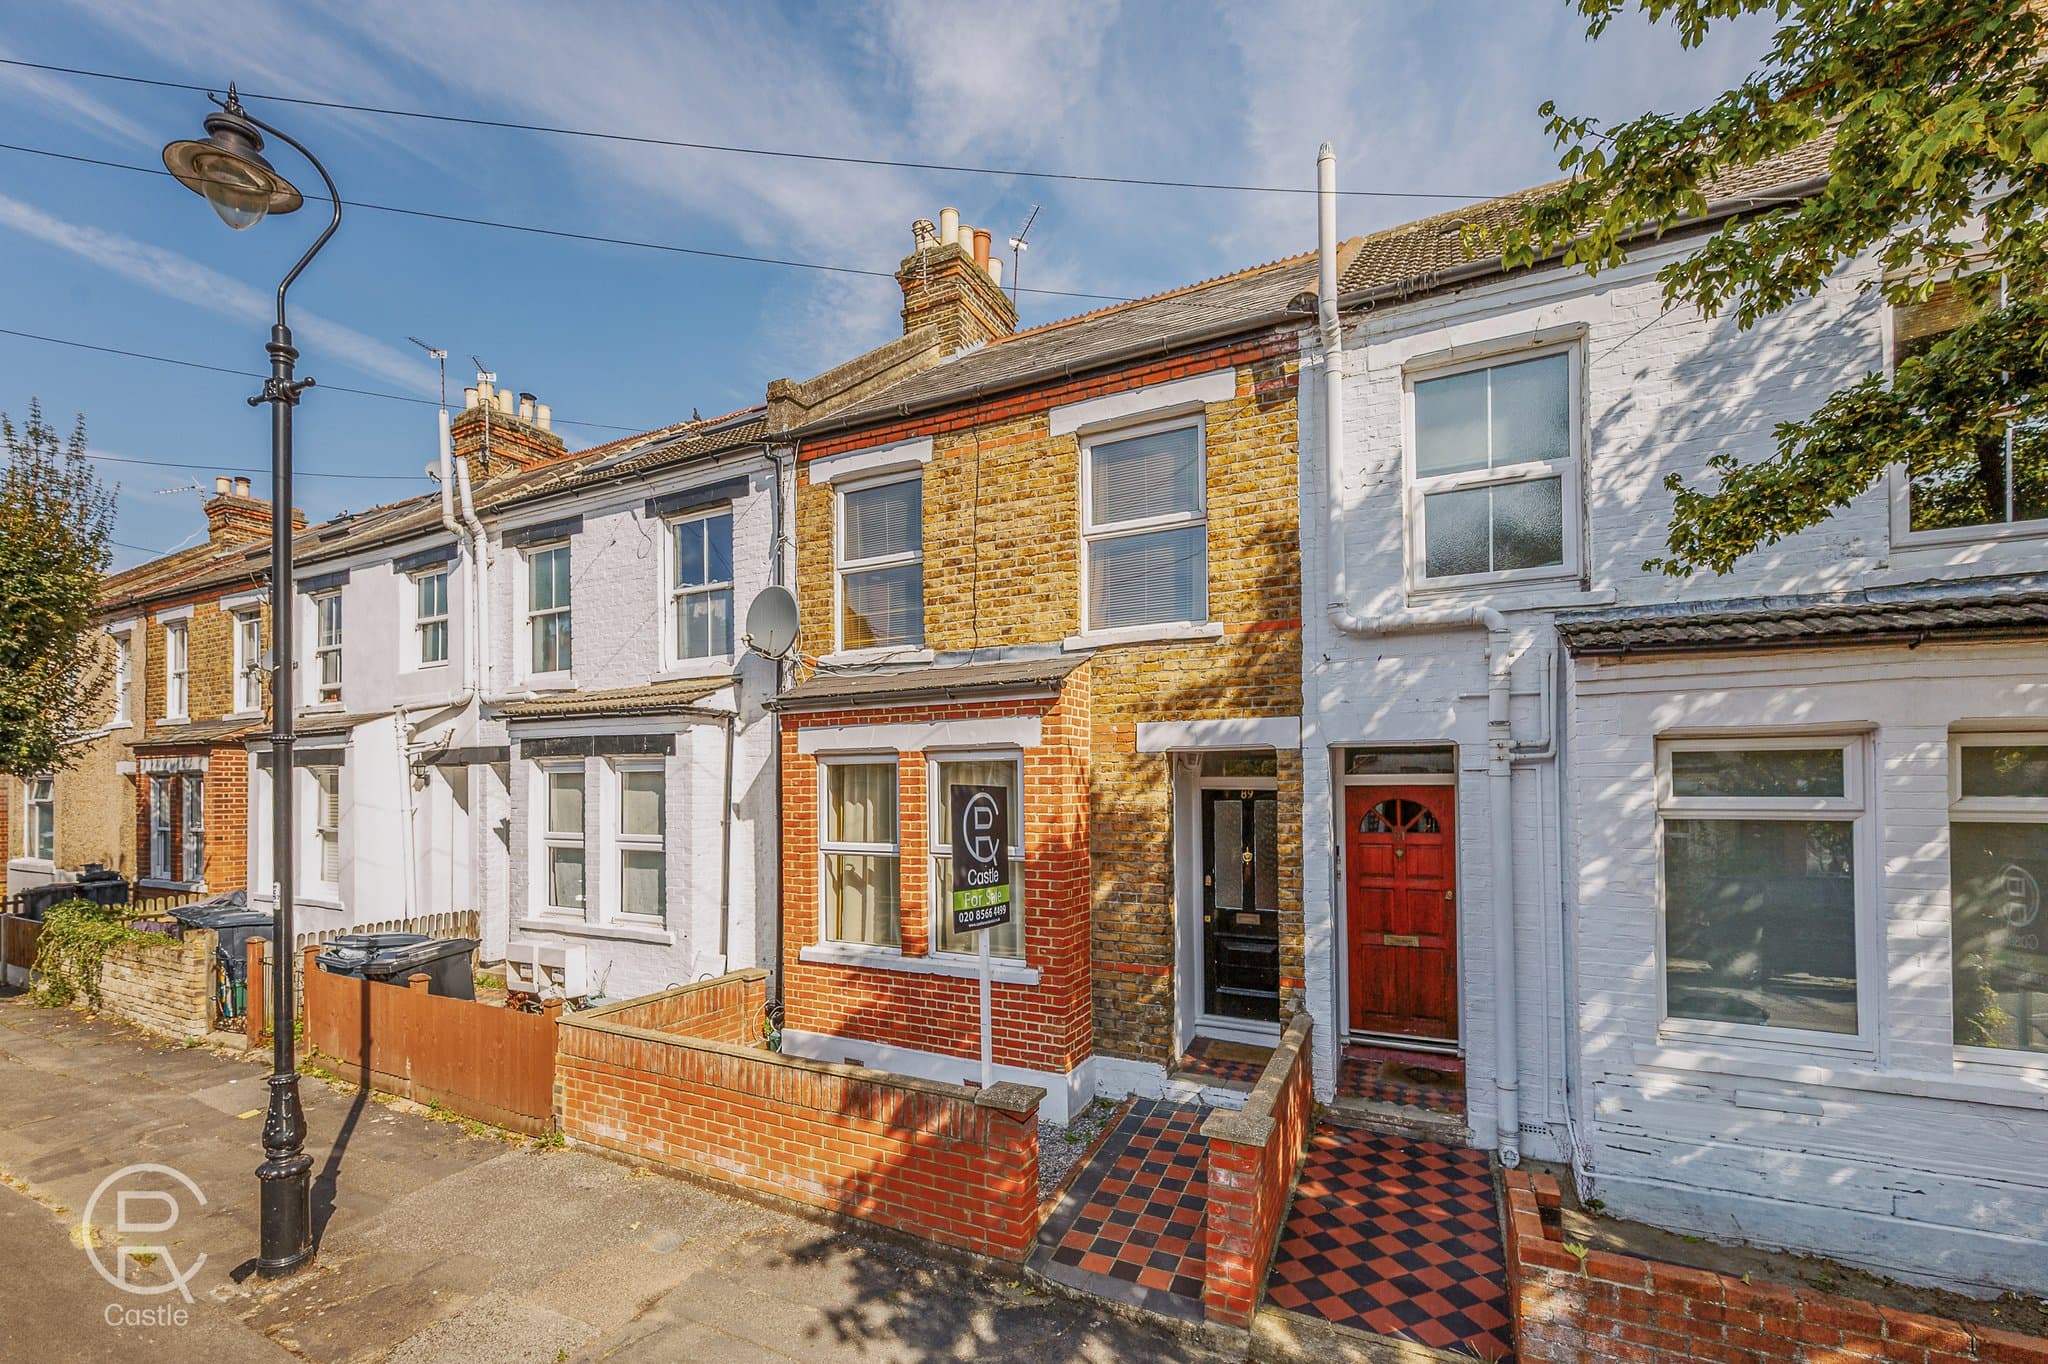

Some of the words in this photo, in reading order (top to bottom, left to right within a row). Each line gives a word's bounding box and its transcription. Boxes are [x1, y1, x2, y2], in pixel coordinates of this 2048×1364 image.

[1240, 788, 1254, 799] 89
[967, 867, 999, 886] Castle
[964, 892, 983, 909] For
[985, 887, 1002, 905] Sale
[958, 911, 974, 924] 020
[975, 908, 993, 920] 8566
